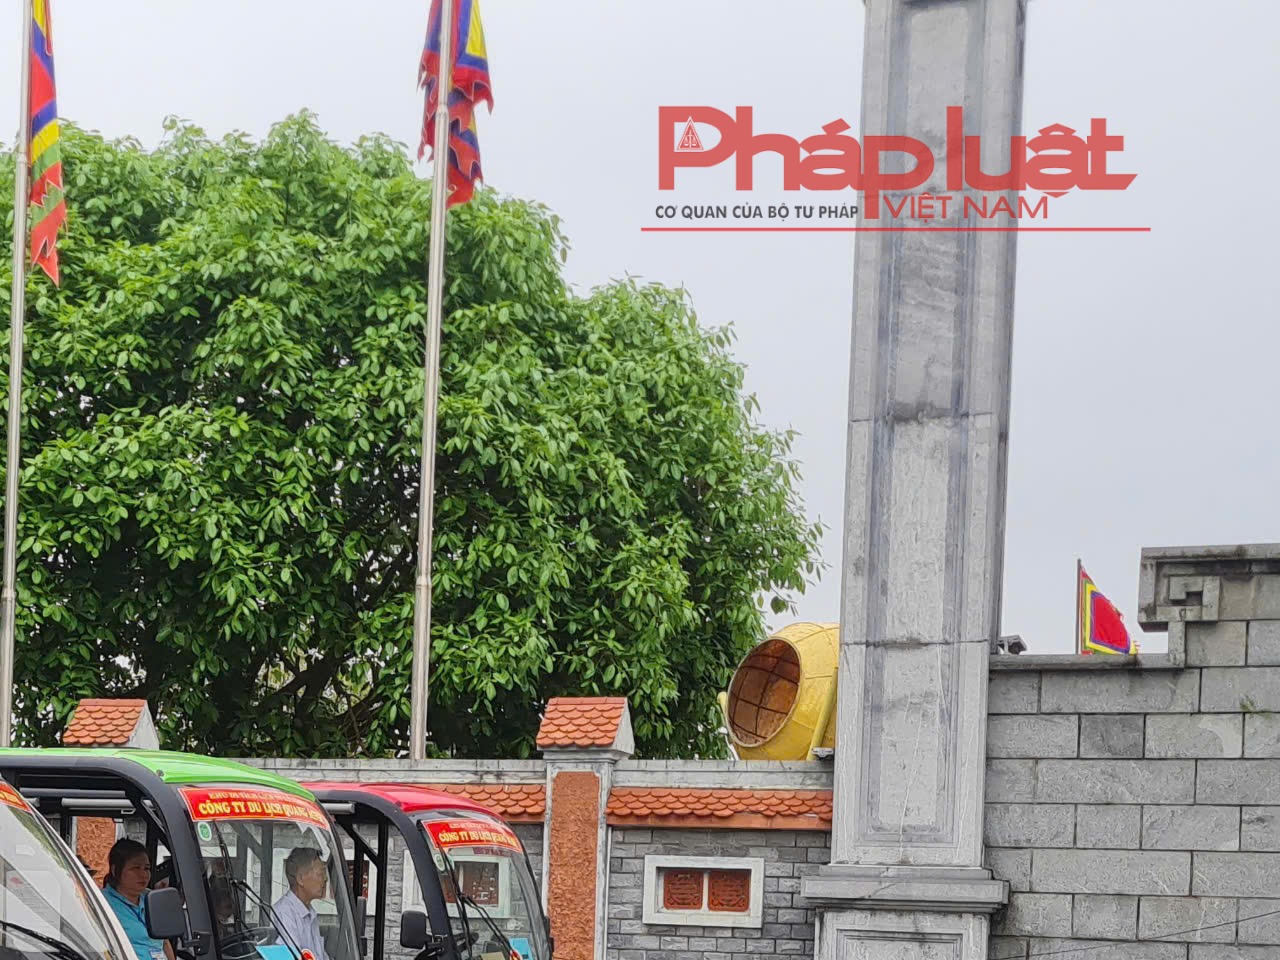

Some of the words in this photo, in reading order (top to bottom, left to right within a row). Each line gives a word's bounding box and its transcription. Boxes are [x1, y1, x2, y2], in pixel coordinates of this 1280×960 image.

[199, 799, 231, 815] CÔNG
[231, 801, 246, 813] TY
[247, 801, 262, 813] DU
